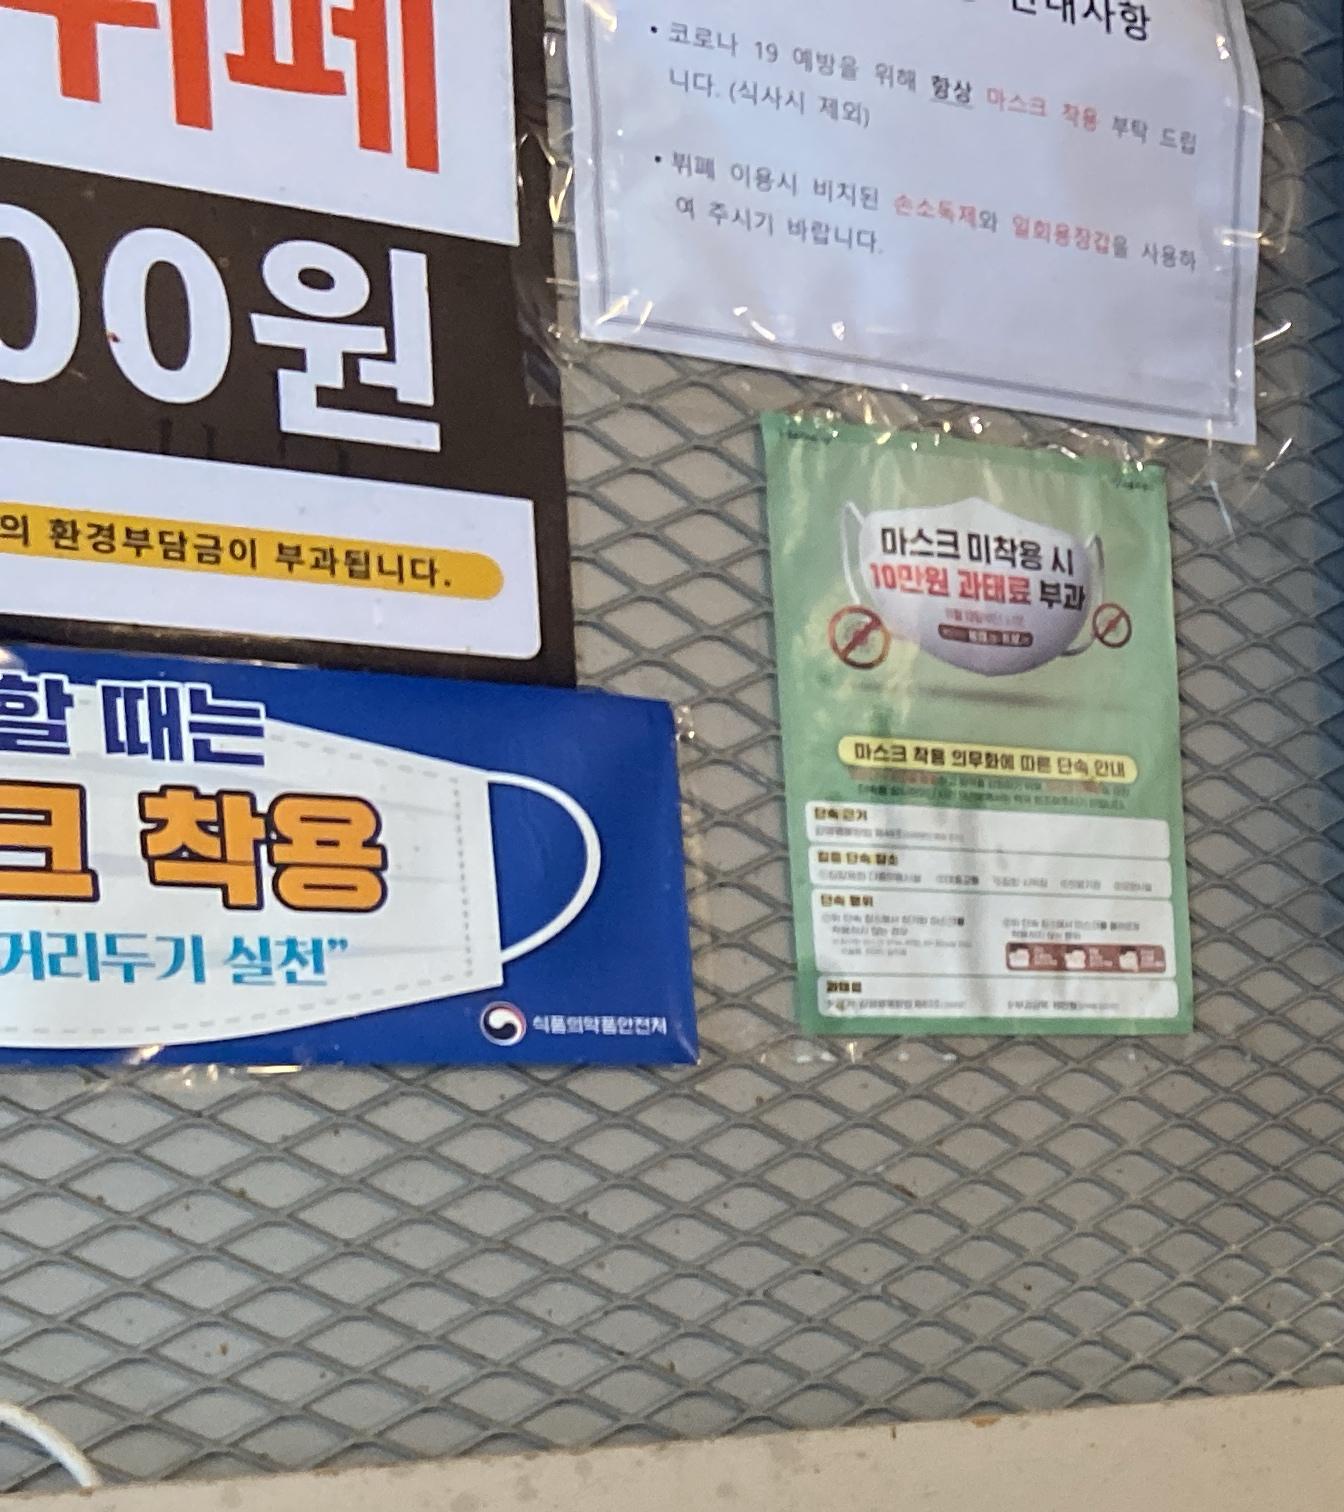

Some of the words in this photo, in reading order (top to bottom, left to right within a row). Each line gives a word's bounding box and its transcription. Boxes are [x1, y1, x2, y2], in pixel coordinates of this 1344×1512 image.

[668, 21, 738, 57] 코로나
[754, 40, 778, 63] 19
[792, 46, 859, 81] 예방을
[874, 62, 917, 92] 위해
[930, 75, 973, 105] 항상
[986, 87, 1047, 117] 마스크
[1112, 115, 1149, 144] 부탁
[1159, 127, 1197, 155] 드립
[729, 79, 806, 115] (식사시
[818, 94, 871, 128] 제외)
[675, 196, 696, 220] 여
[708, 200, 775, 236] 주시기
[787, 217, 884, 254] 바랍니다.
[730, 162, 799, 197] 이용시
[813, 177, 880, 211] 비치된
[894, 193, 998, 233] 손소독제와
[1012, 213, 1128, 258] 일회용장갑을
[1142, 240, 1197, 273] 사용하
[49, 518, 257, 571] 환경부담금이
[275, 541, 452, 588] 부과됩니다.
[881, 526, 961, 560] 마스크
[967, 532, 1043, 572] 미착용
[1051, 545, 1075, 577] 시
[870, 562, 950, 597] 10만원
[957, 567, 1032, 606] 과태료
[1039, 578, 1087, 612] 부과
[100, 684, 266, 767] 때는
[854, 741, 907, 763] 마스크
[1020, 753, 1052, 774] 따른
[138, 785, 389, 912] 착용
[0, 930, 206, 984] 거리두기
